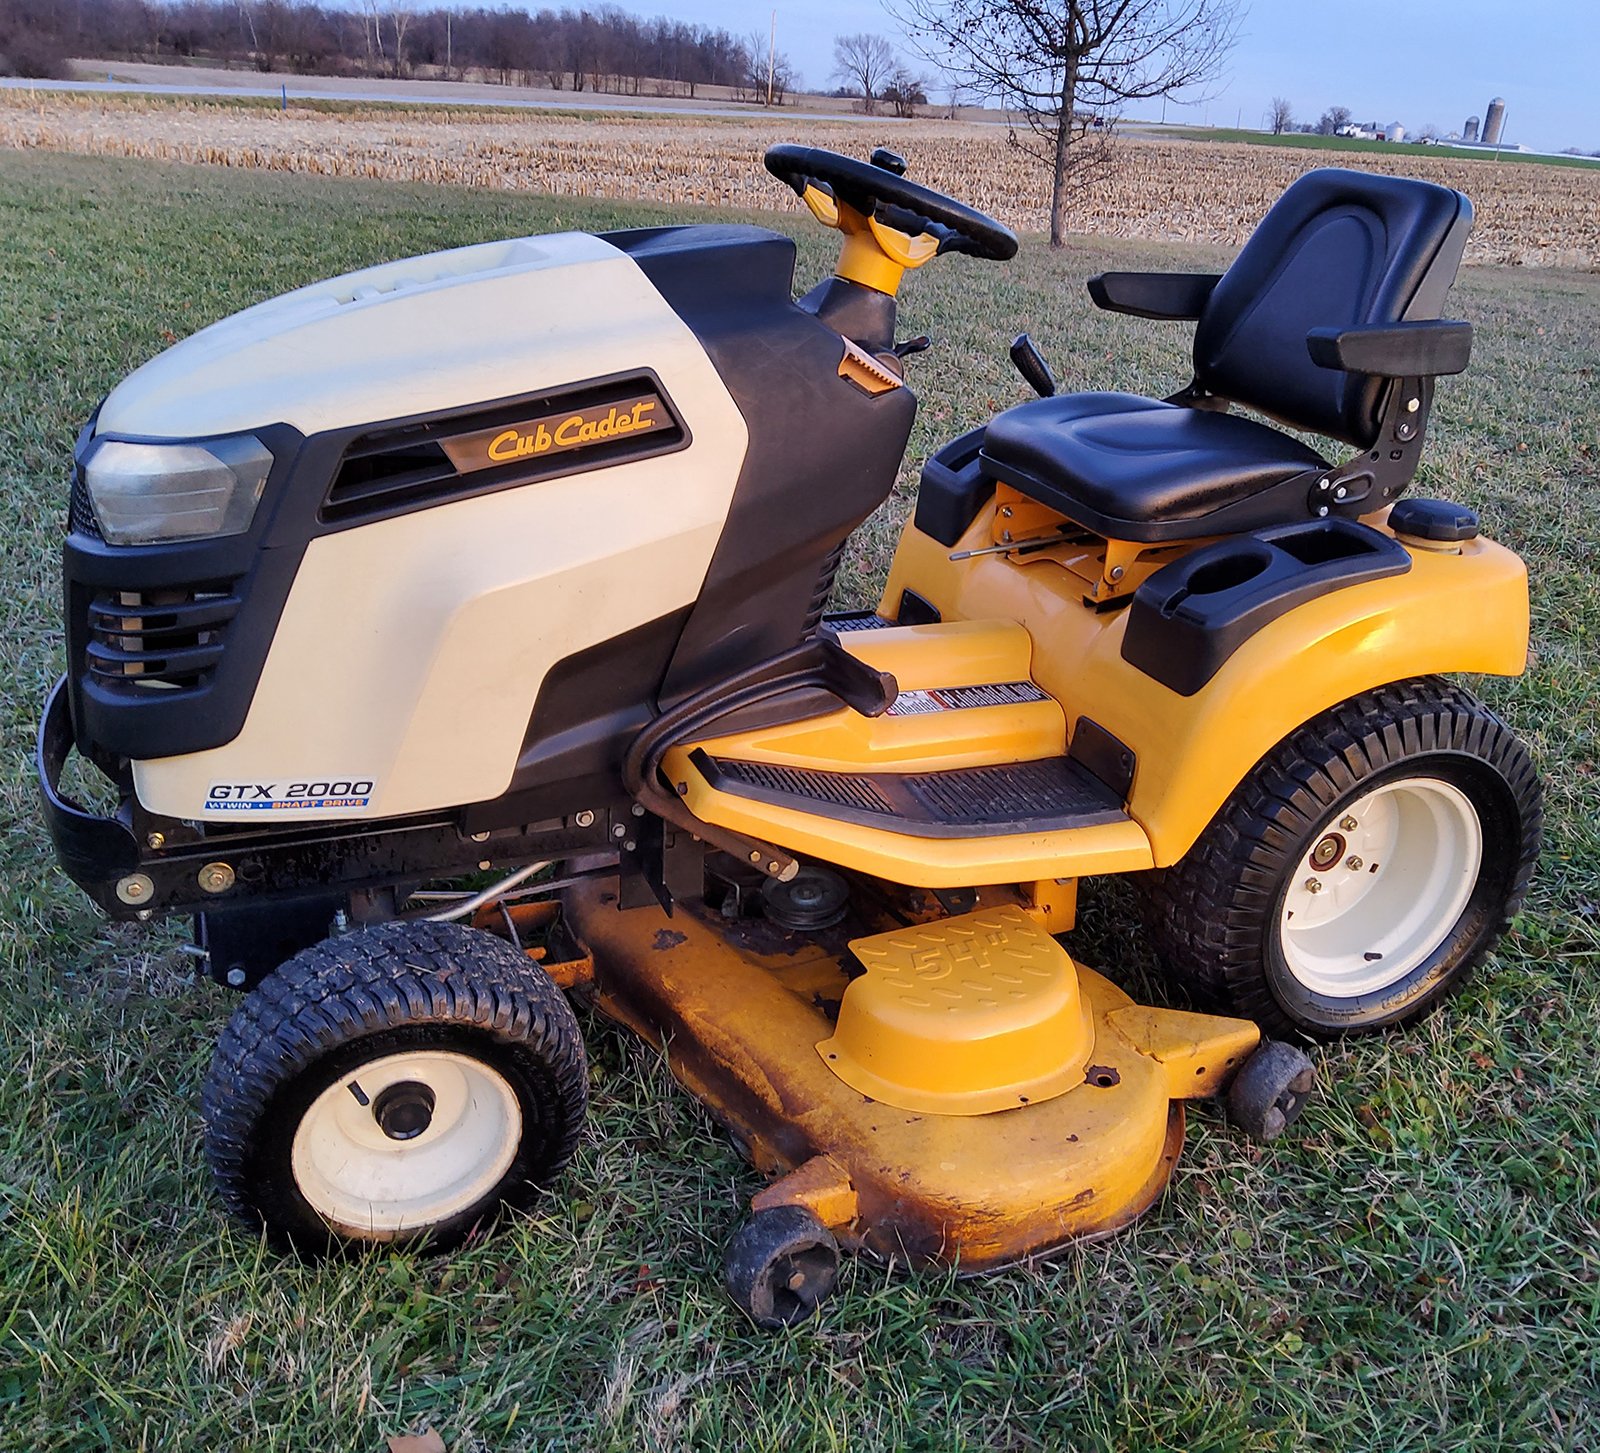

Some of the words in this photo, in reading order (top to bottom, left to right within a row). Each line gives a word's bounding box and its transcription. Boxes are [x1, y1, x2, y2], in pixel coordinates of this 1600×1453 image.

[487, 423, 552, 461] Cub
[554, 401, 656, 447] Cadet
[208, 784, 277, 799] GTX
[285, 781, 374, 798] 2000
[272, 801, 318, 809] SHAFT
[322, 799, 364, 807] DRIVE
